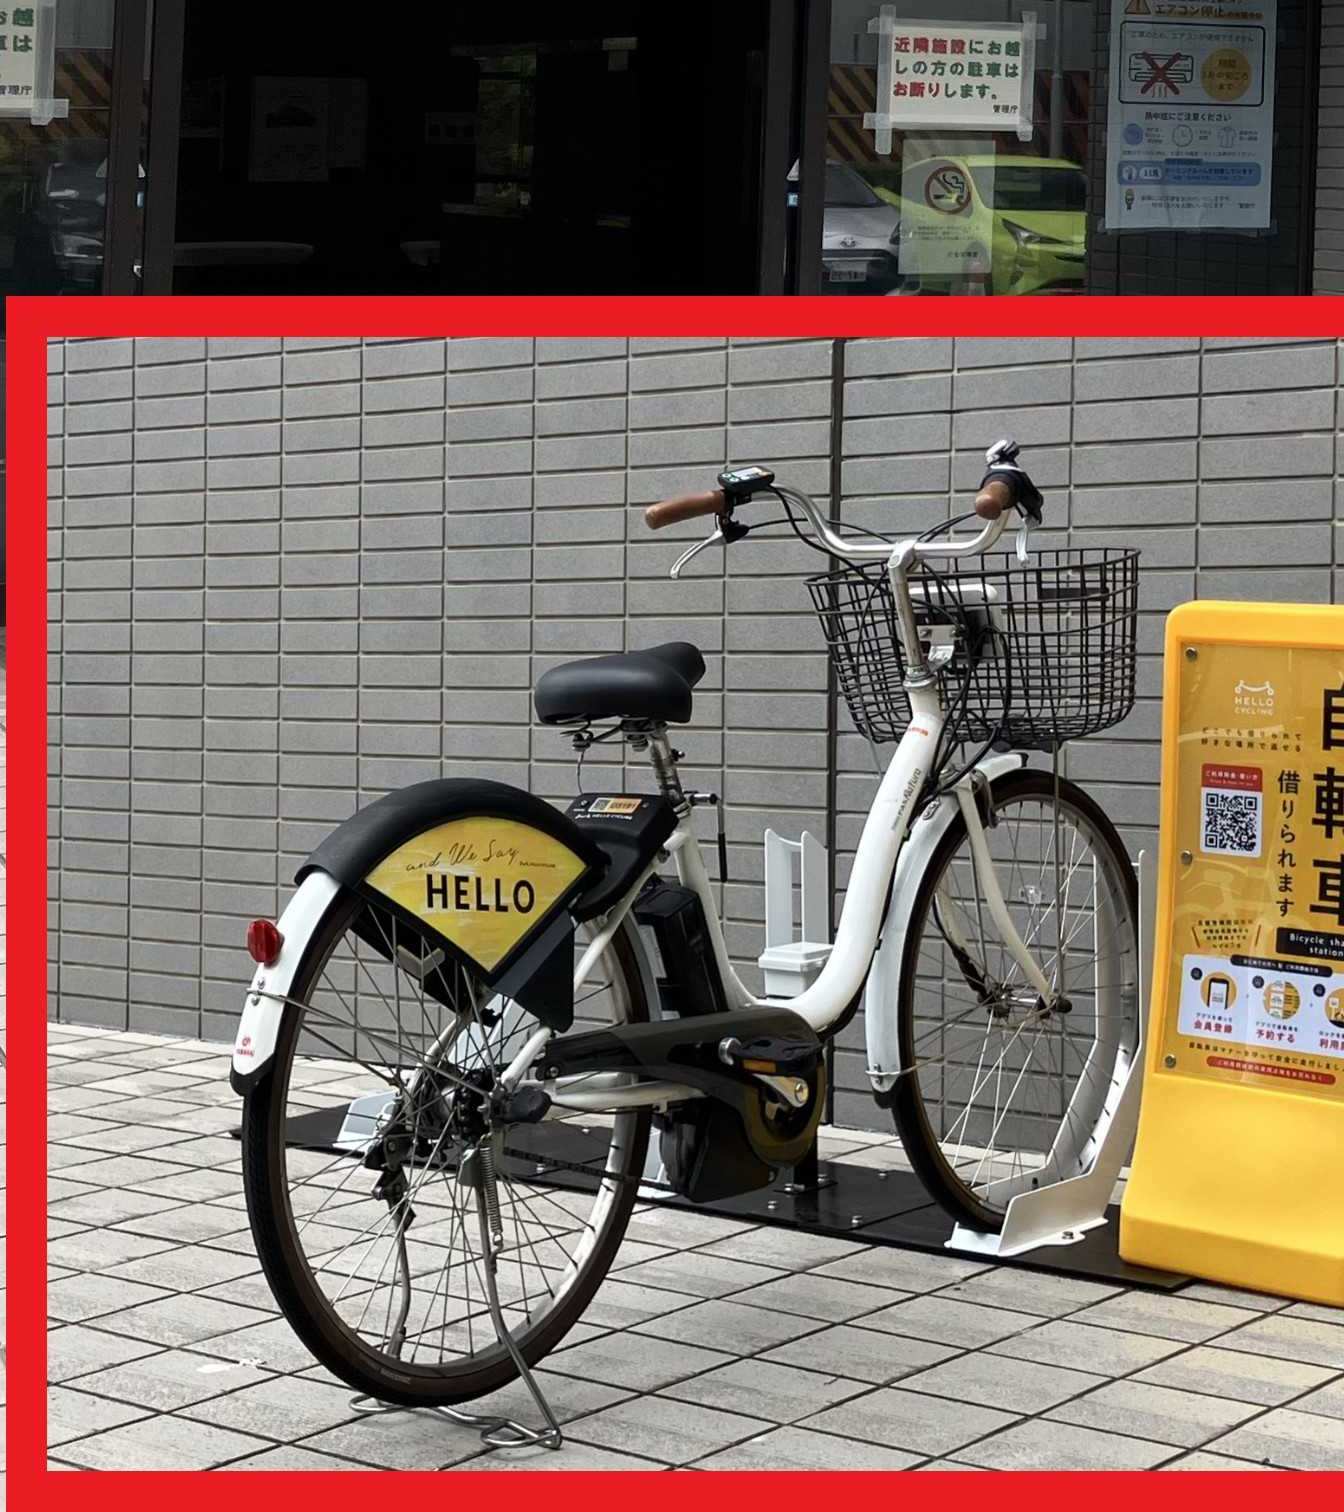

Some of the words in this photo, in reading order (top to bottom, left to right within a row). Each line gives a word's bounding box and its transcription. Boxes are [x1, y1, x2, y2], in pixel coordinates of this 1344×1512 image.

[894, 37, 1020, 57] 近隣施設にお越
[895, 59, 1019, 78] しの方の駐車は
[893, 81, 997, 100] お断りします。
[1234, 696, 1274, 707] HELLO
[449, 842, 478, 866] We
[482, 839, 520, 866] Say
[1276, 769, 1301, 918] 借りられます
[426, 873, 535, 914] HELLO
[1289, 932, 1325, 946] Bicycle
[1309, 946, 1344, 958] station
[1194, 1020, 1233, 1034] 会員登録
[1256, 1029, 1296, 1044] 予約する
